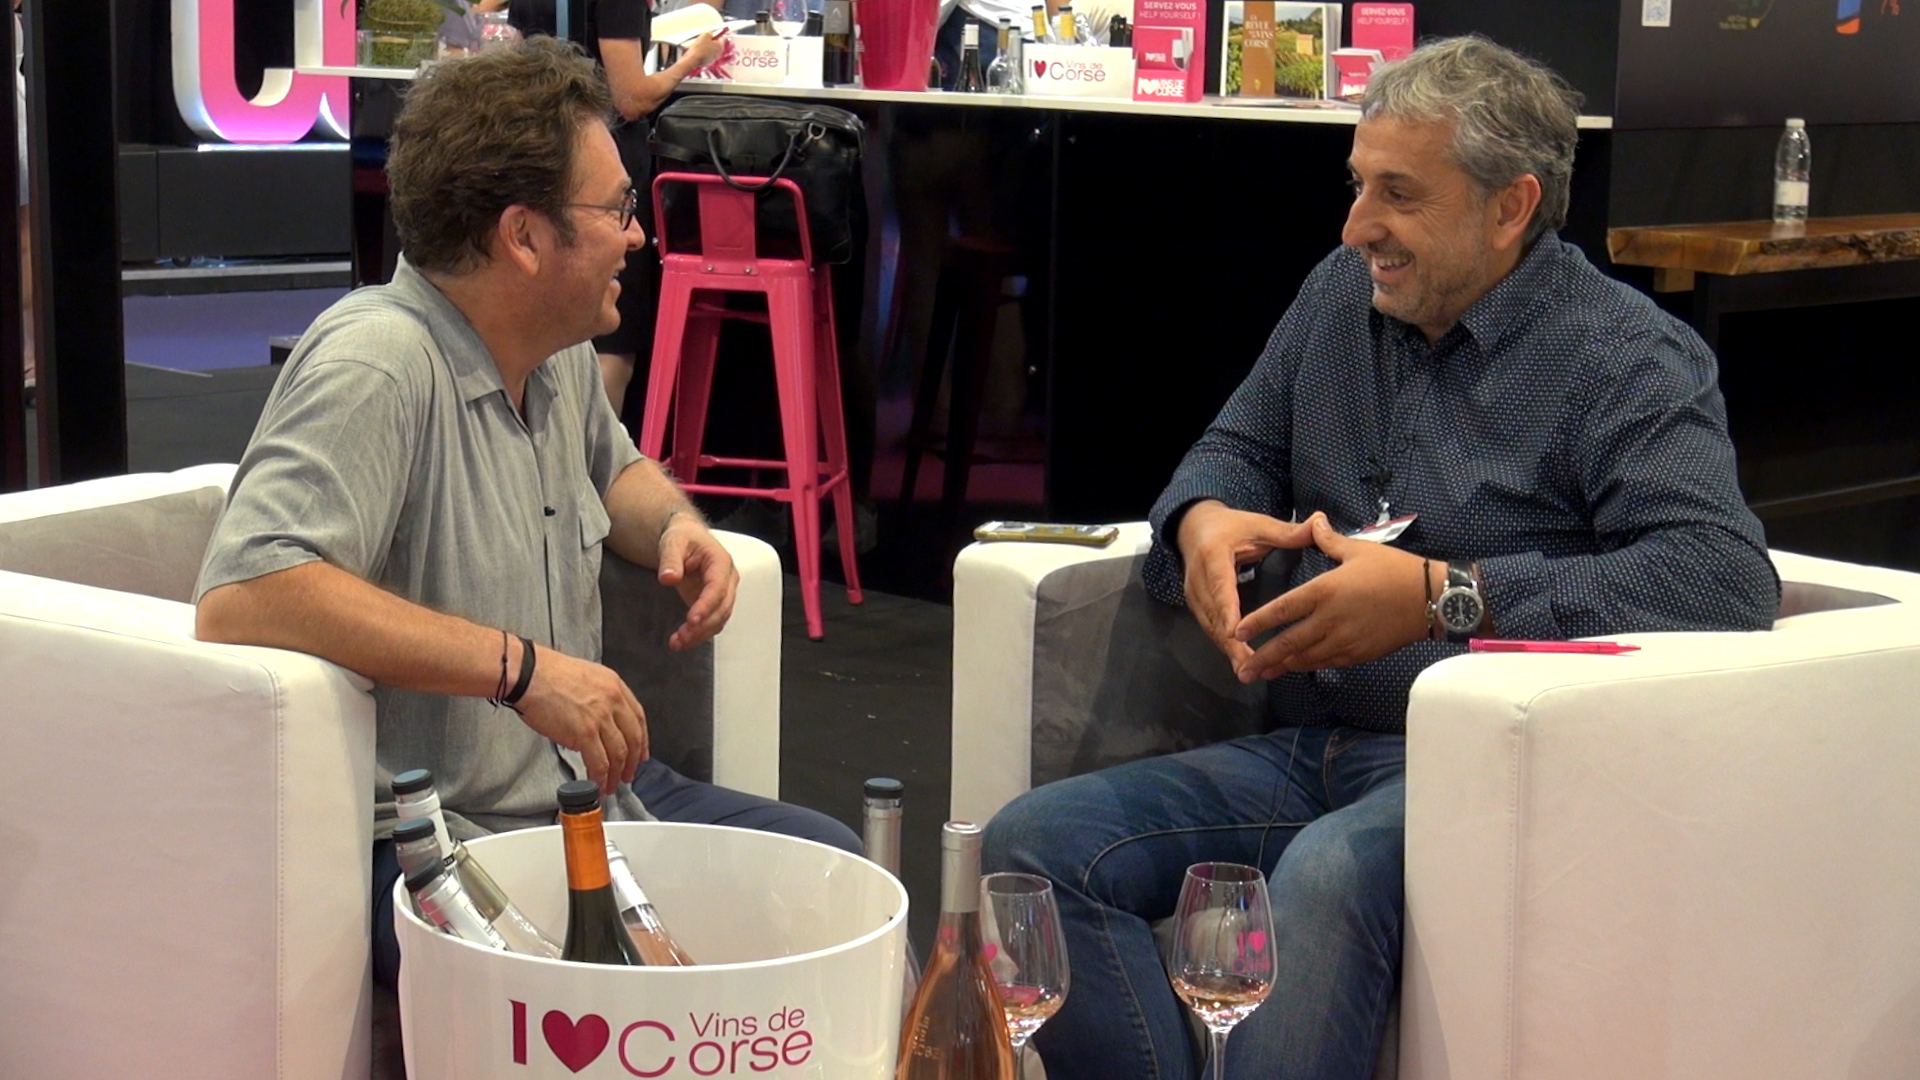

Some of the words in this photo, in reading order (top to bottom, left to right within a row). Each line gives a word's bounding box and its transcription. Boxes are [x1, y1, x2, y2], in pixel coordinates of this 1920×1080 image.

[1357, 17, 1373, 25] HELP
[741, 47, 761, 56] Vins
[763, 49, 776, 57] de
[1028, 58, 1033, 79] I
[1049, 61, 1106, 82] Corse
[1066, 60, 1087, 69] Vins
[1089, 62, 1103, 70] de
[689, 1011, 758, 1037] Vins
[768, 1006, 806, 1032] de
[508, 998, 528, 1066] I
[618, 1020, 813, 1078] Corse
